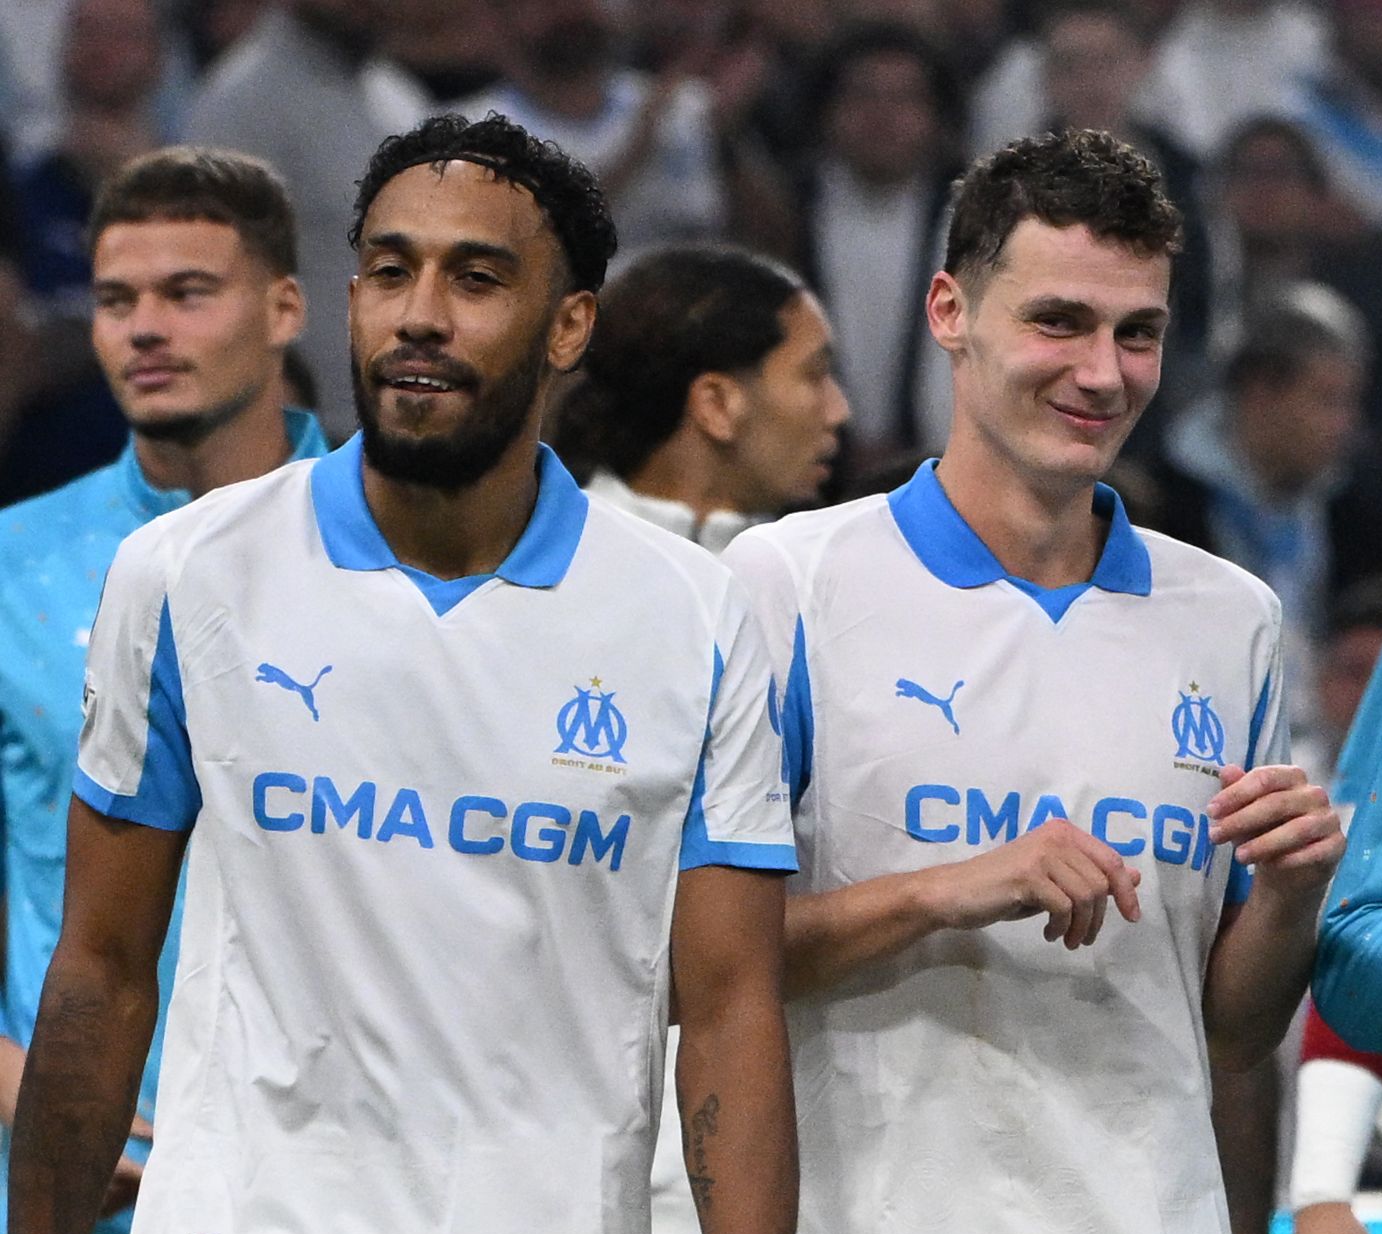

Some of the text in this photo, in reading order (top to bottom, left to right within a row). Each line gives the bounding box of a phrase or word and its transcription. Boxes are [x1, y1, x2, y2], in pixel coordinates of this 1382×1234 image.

[551, 758, 585, 769] DROIT
[252, 772, 631, 872] CMA CGM
